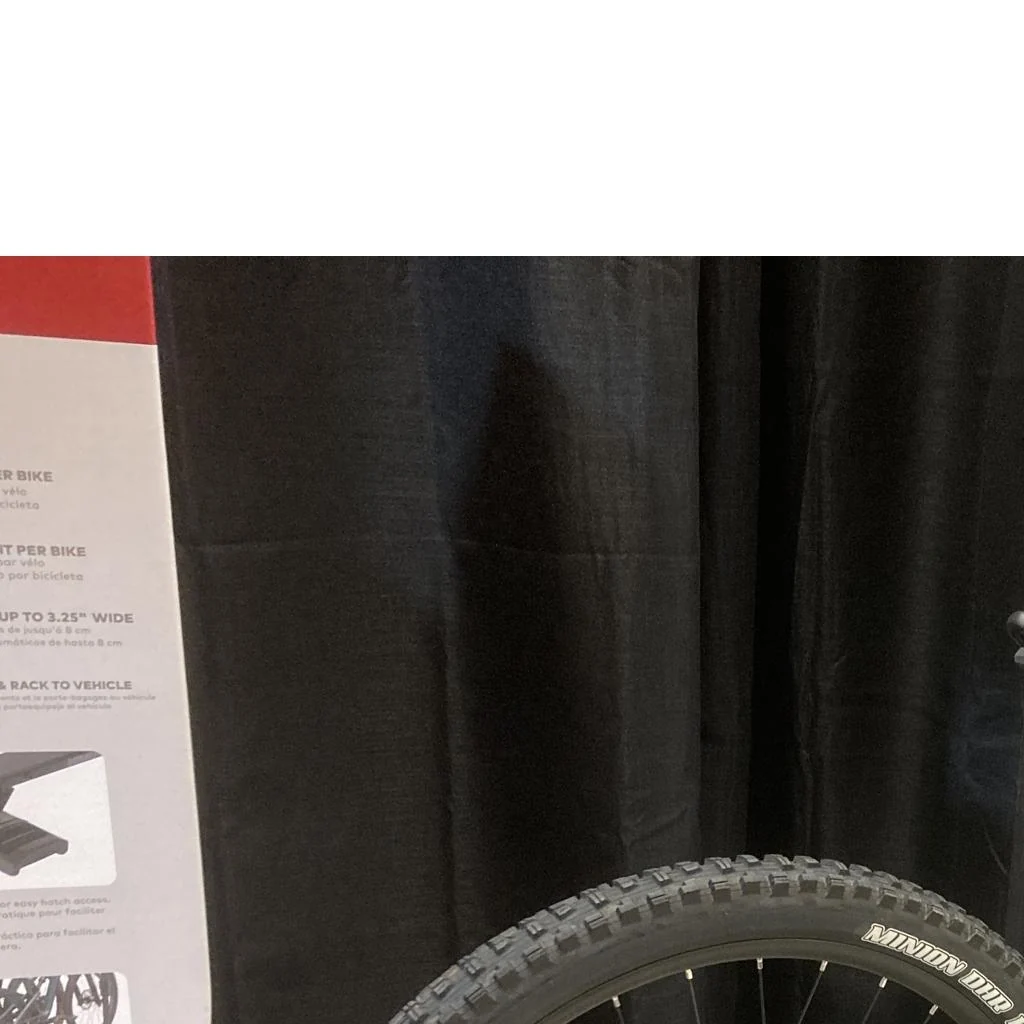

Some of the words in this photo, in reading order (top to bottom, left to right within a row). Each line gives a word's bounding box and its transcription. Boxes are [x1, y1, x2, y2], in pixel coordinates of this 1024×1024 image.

[17, 470, 54, 482] BIKE
[17, 545, 47, 557] PER
[50, 546, 87, 557] BIKE
[0, 611, 19, 622] UP
[22, 611, 44, 622] TO
[92, 612, 135, 624] WIDE
[10, 680, 49, 690] RACK
[51, 681, 71, 690] TO
[73, 681, 133, 691] VEHICLE
[14, 900, 38, 909] easy
[40, 897, 71, 906] hatch
[861, 922, 968, 977] MINION
[957, 967, 1015, 1015] DHR
